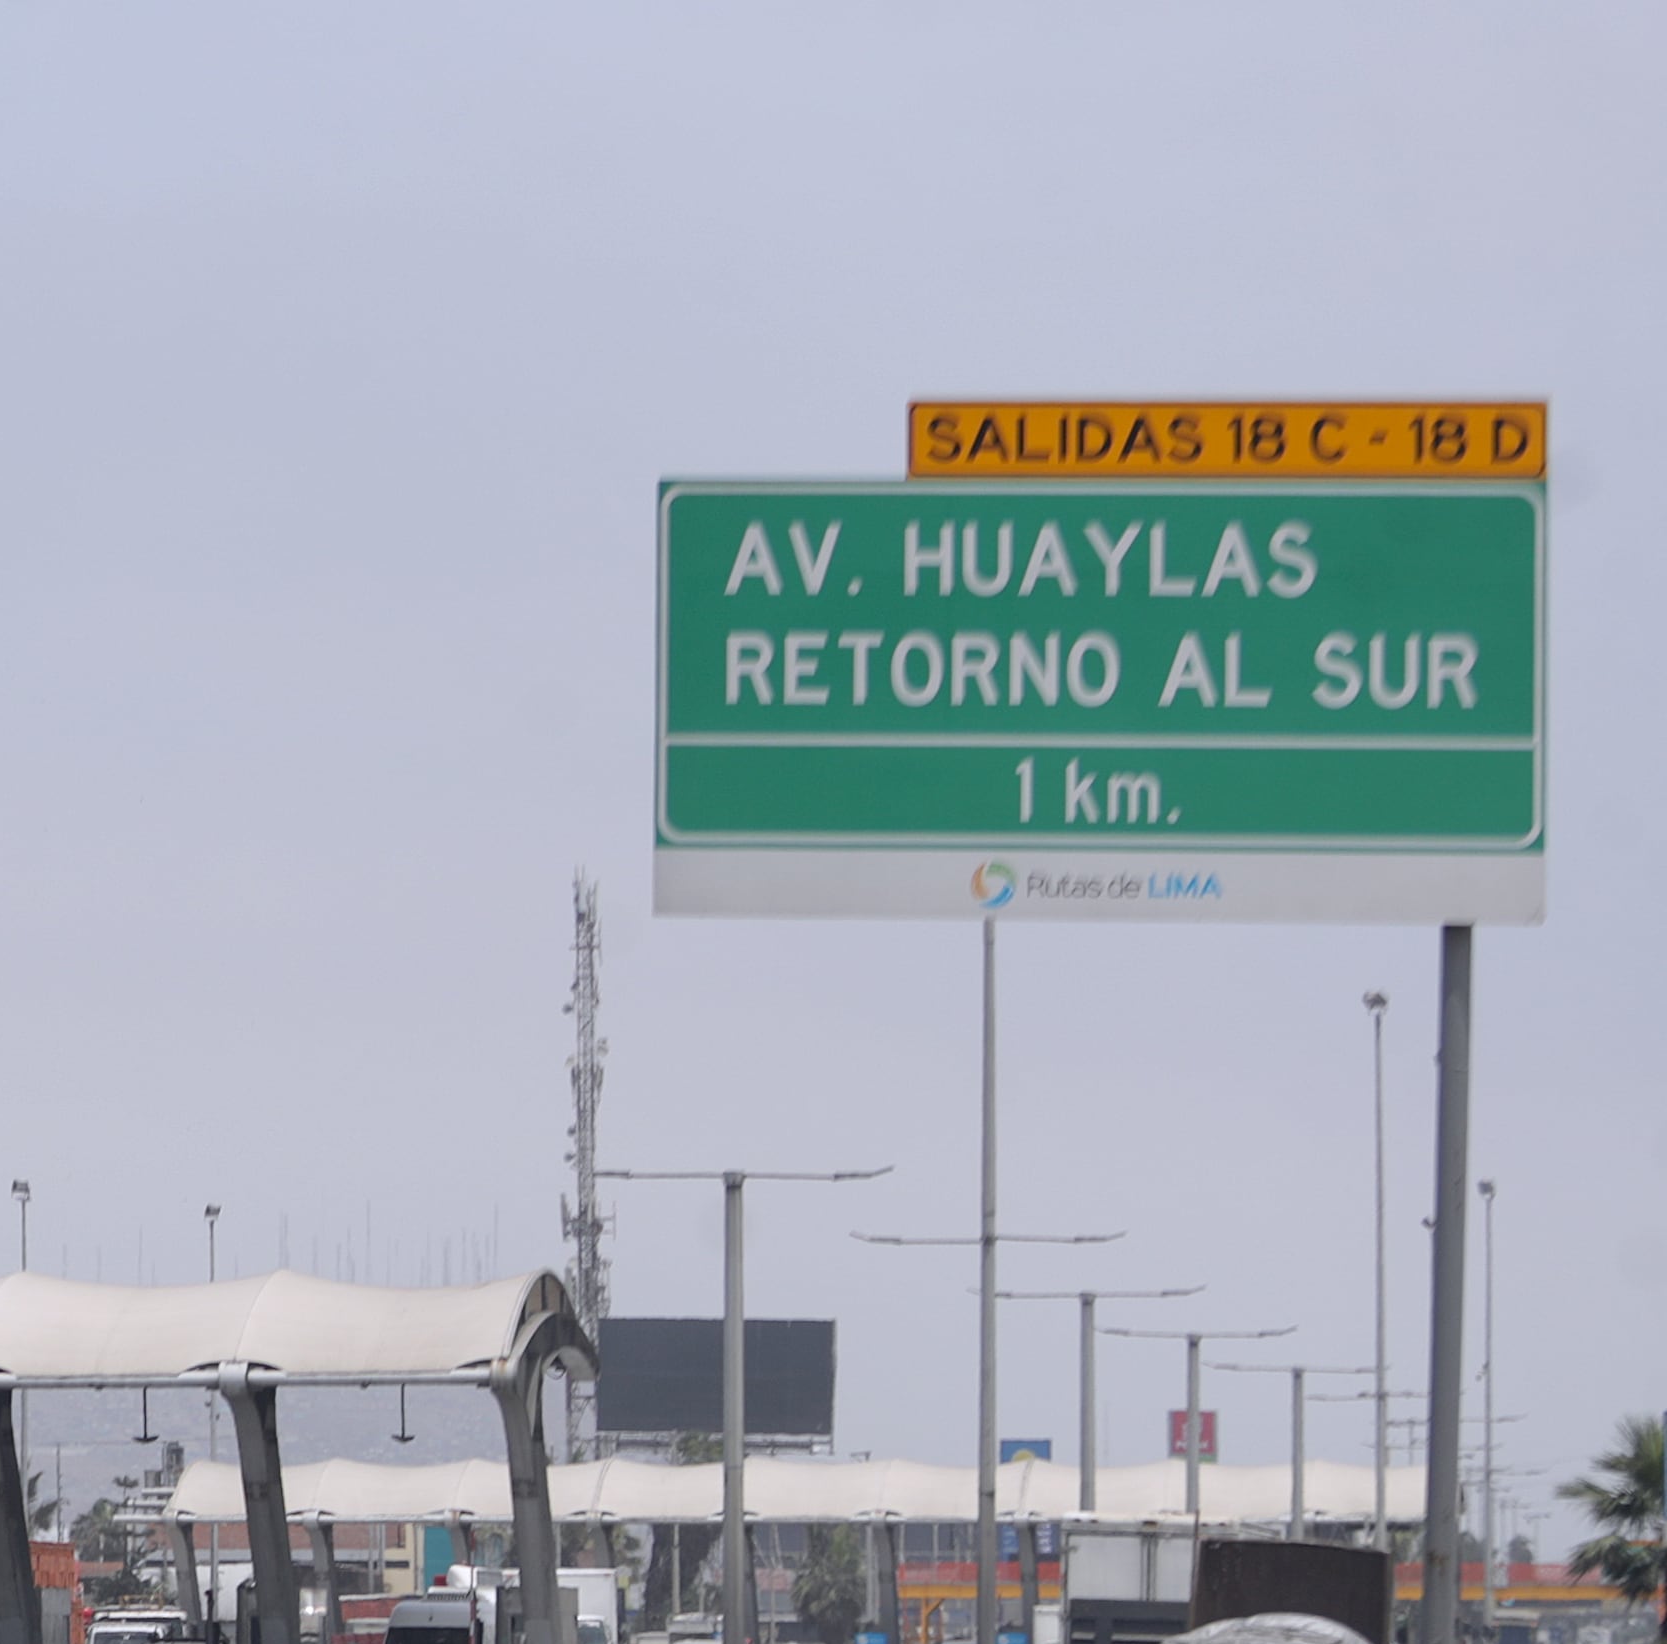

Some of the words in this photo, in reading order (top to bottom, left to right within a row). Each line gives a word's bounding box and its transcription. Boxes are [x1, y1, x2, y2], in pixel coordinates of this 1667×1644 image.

[927, 412, 1204, 463] SALIDAS
[1228, 413, 1287, 464] 18
[1310, 413, 1349, 464] C
[1369, 427, 1388, 446] -
[1409, 413, 1467, 464] 18
[1491, 414, 1530, 464] D
[724, 519, 864, 597] AV.
[904, 519, 1318, 598] HUAYLAS
[725, 630, 1121, 708] RETORNO
[1158, 630, 1273, 708] AL
[1312, 630, 1479, 709] SUR
[1015, 756, 1035, 824] 1
[1065, 757, 1182, 825] km.
[1026, 871, 1103, 898] Rutas
[1106, 871, 1142, 898] de
[1147, 871, 1223, 899] LIMA
